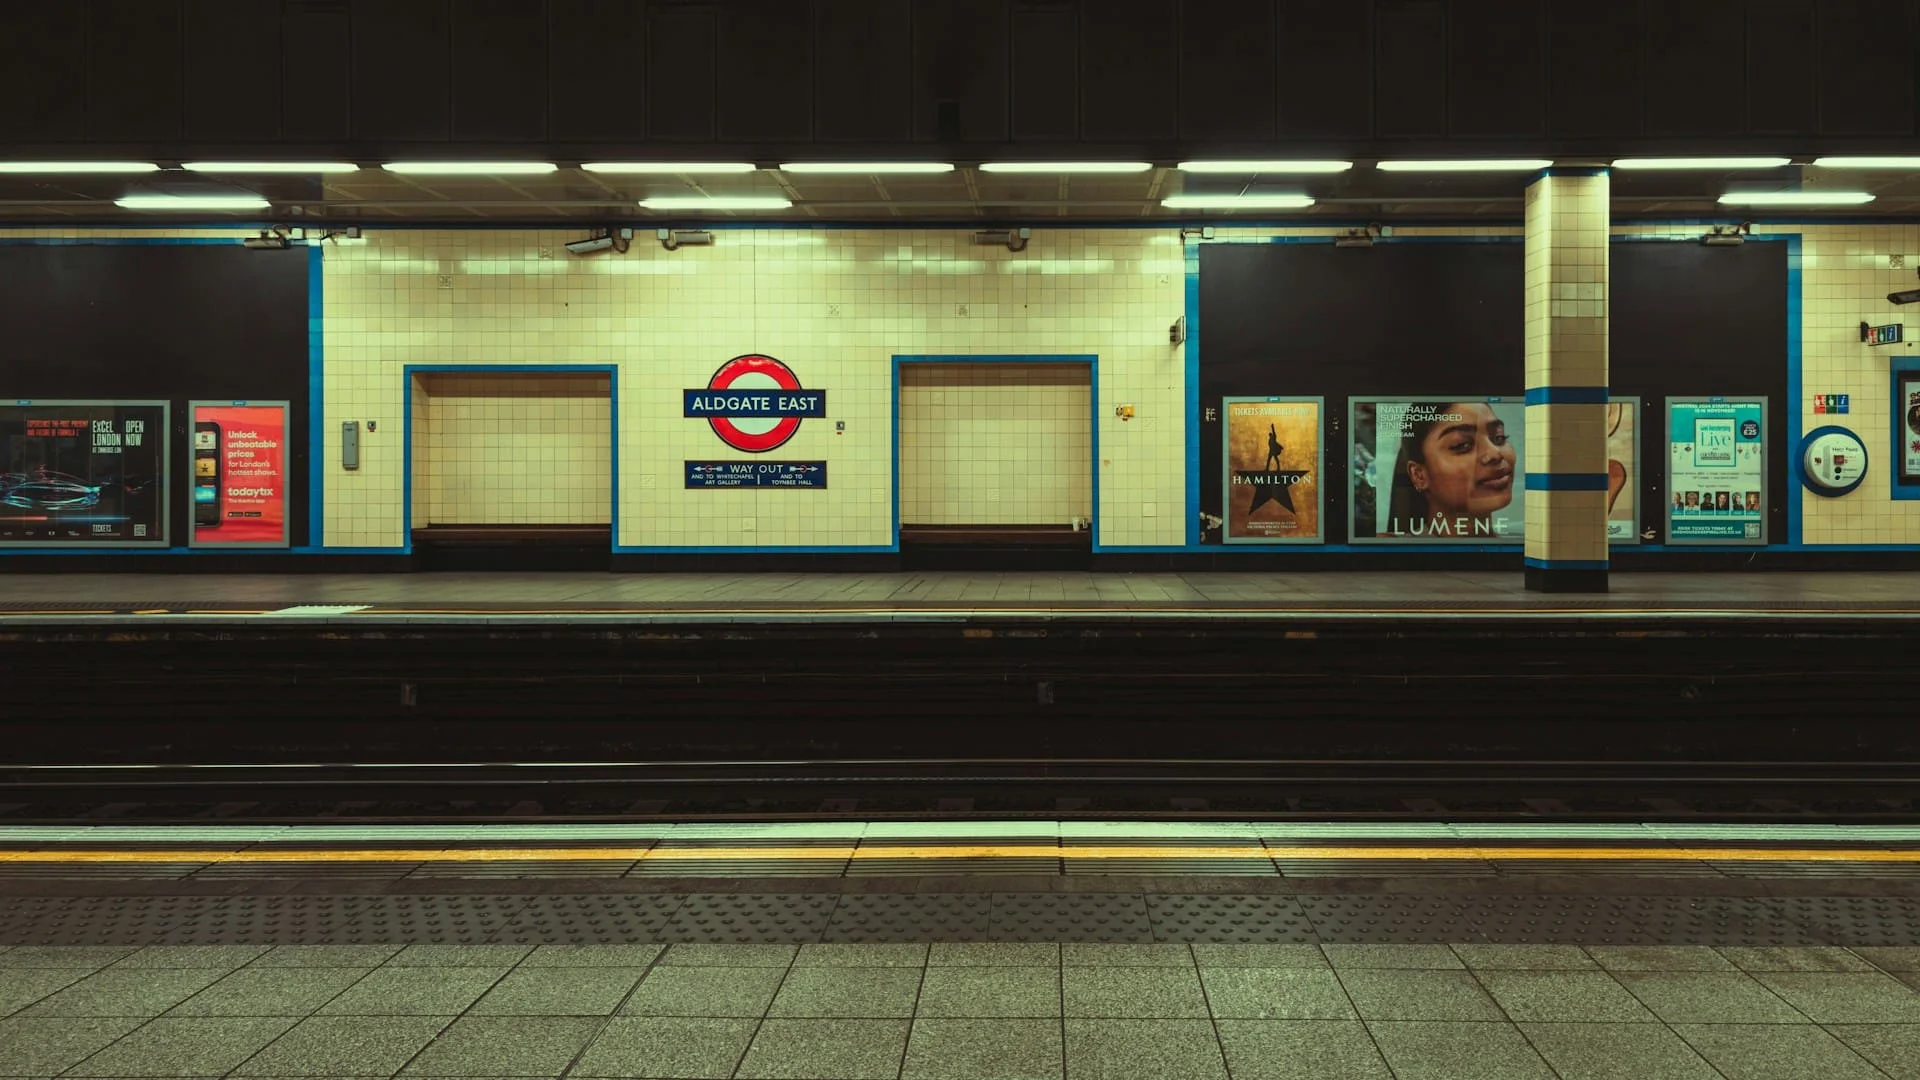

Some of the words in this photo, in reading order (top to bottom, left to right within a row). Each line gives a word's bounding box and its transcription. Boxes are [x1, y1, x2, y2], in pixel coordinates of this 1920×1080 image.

[692, 397, 771, 411] ALDGATE
[778, 397, 817, 411] EAST
[125, 420, 144, 433] OPEN
[92, 434, 121, 446] LONDON
[125, 434, 142, 446] NOW
[228, 431, 257, 439] Unlock
[1701, 432, 1731, 446] Live
[228, 440, 277, 448] unbeatable
[228, 450, 255, 459] prices
[730, 465, 754, 473] WAY
[758, 465, 783, 473] OUT
[1232, 475, 1312, 485] HAMILTON
[228, 487, 274, 498] todaytix
[1394, 512, 1509, 535] LUMENE
